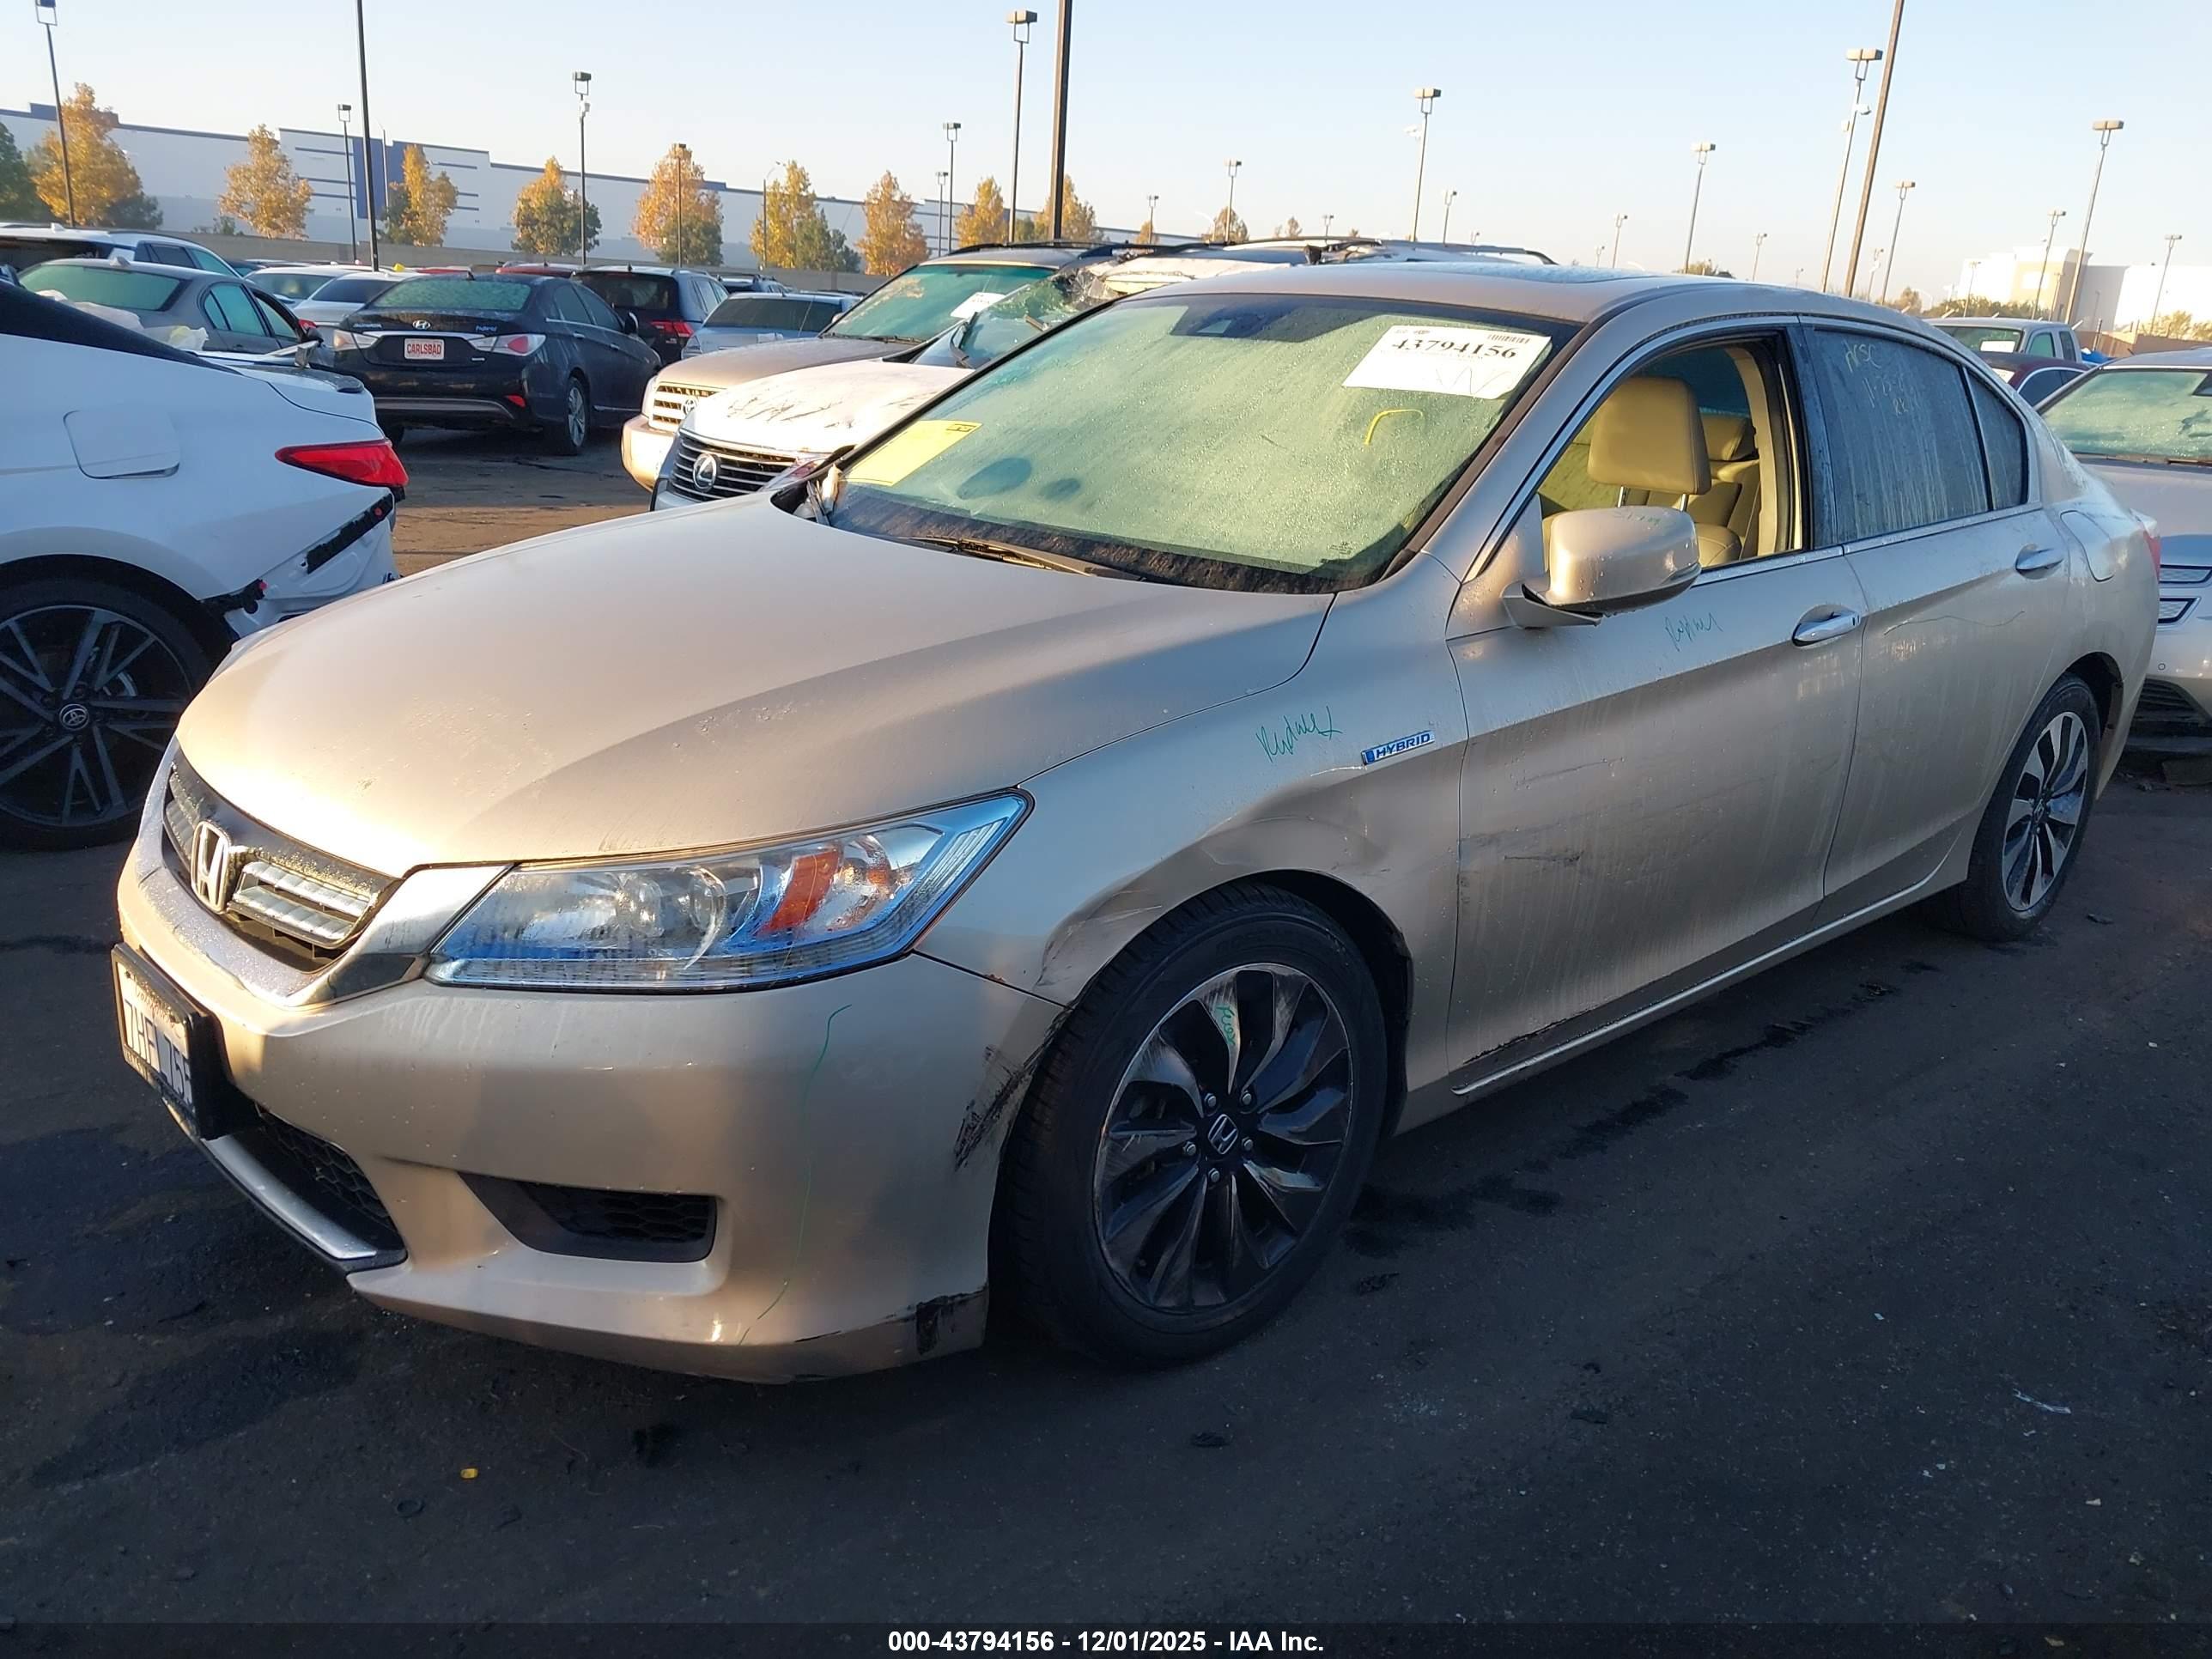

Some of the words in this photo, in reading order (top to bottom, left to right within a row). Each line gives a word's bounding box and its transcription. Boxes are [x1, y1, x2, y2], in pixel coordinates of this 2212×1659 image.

[406, 343, 442, 356] CARLSBAD
[1391, 338, 1516, 359] 43794156
[1376, 732, 1431, 760] HYBRID
